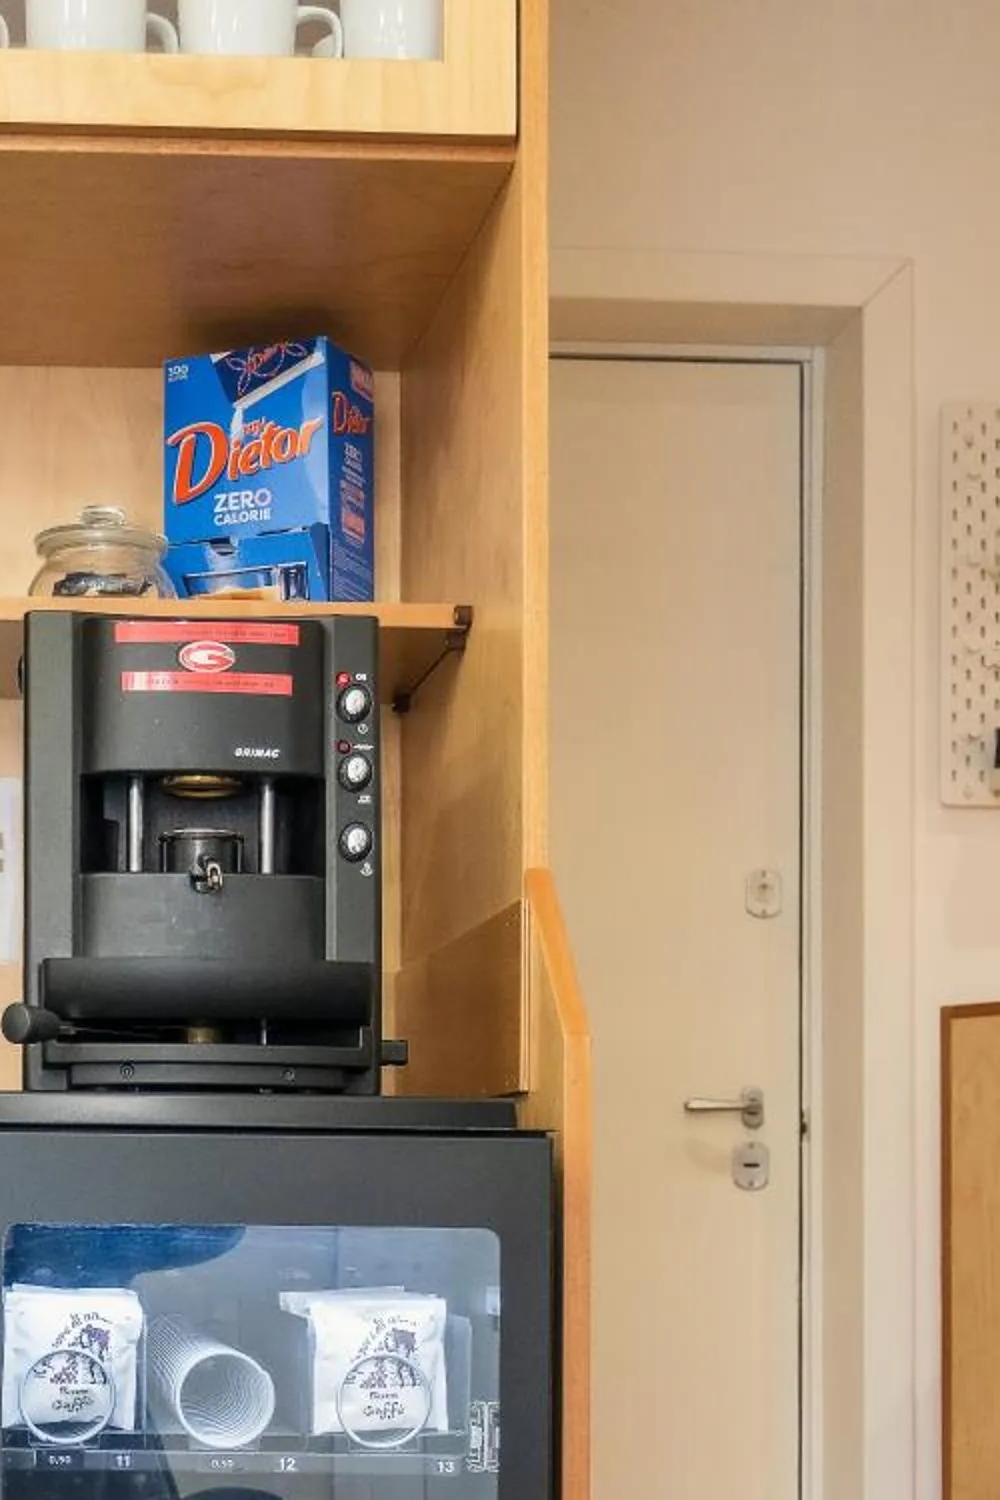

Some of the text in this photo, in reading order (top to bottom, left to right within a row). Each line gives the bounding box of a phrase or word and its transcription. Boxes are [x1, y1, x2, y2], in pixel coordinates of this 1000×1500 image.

[167, 415, 324, 505] Dietor
[213, 488, 272, 513] ZERO
[213, 510, 271, 526] CALORIE
[234, 747, 281, 759] GRIMAC
[115, 1454, 131, 1468] 11
[279, 1457, 297, 1471] 12
[437, 1461, 455, 1473] 13
